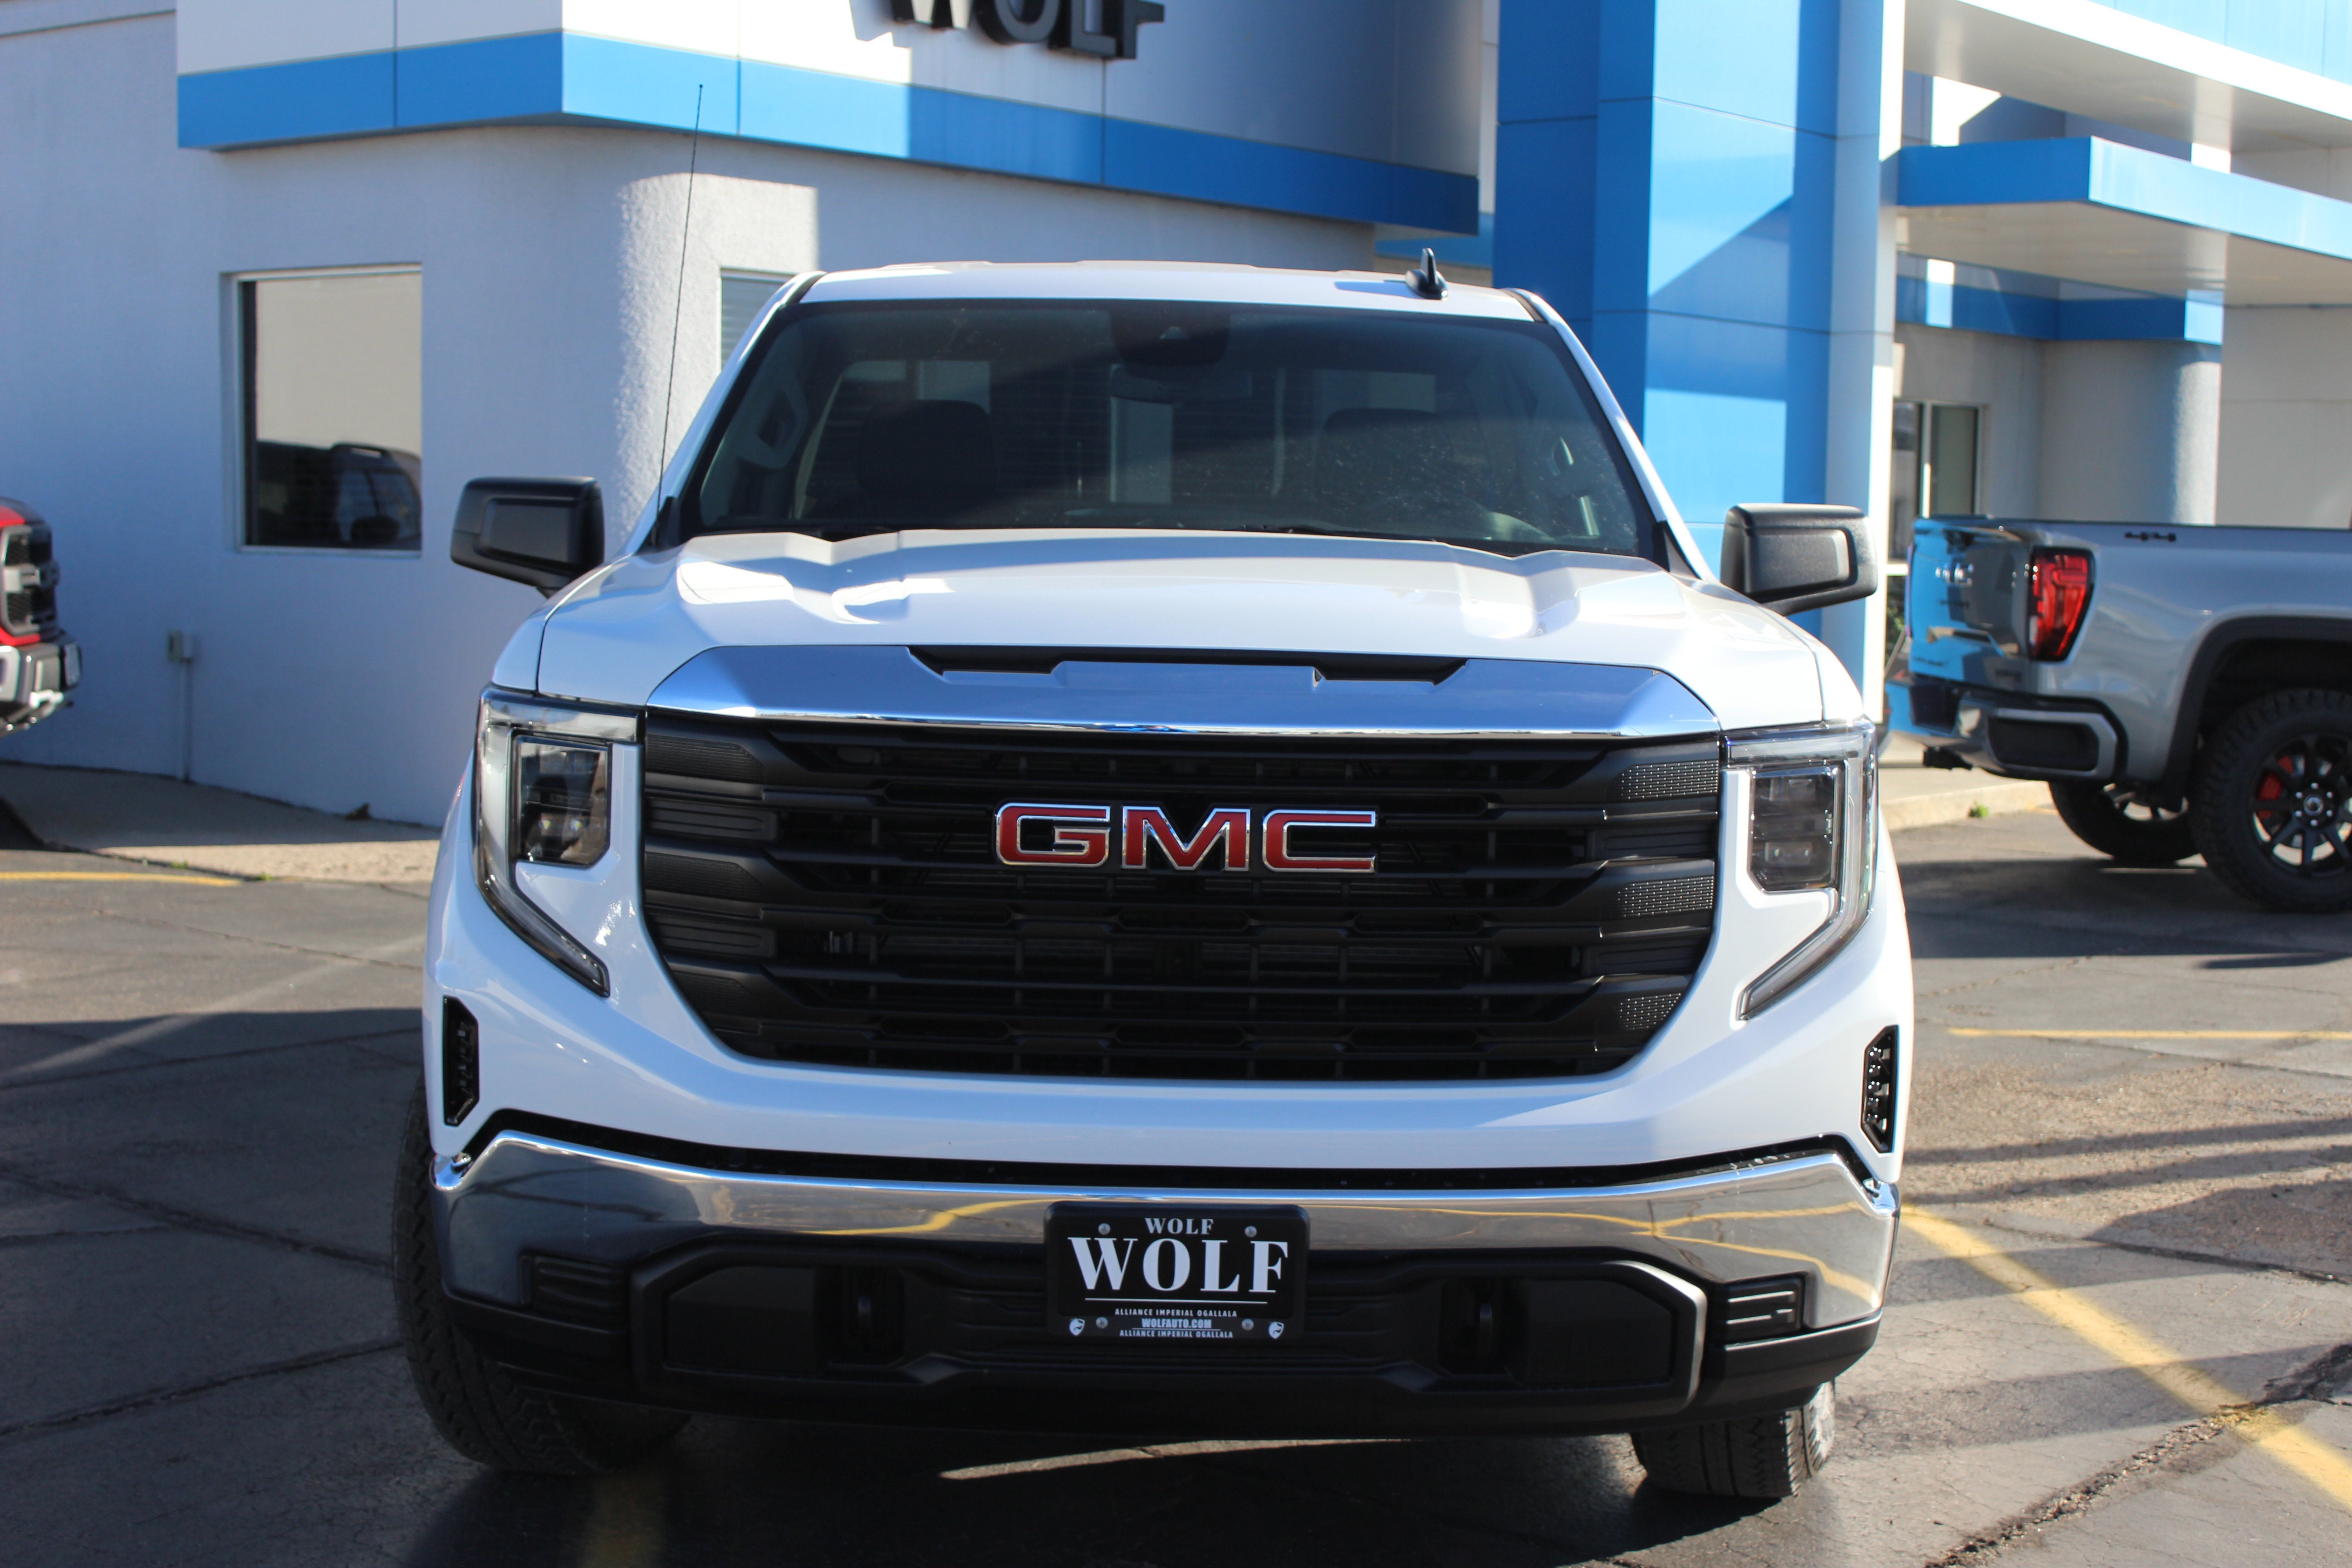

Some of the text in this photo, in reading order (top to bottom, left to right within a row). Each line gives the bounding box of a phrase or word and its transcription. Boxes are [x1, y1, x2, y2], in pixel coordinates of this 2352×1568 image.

[995, 802, 1376, 873] GMC
[1144, 1217, 1214, 1235] WOLF
[1067, 1237, 1289, 1293] WOLF
[1141, 1318, 1212, 1328] WOLFAUTO.COM
